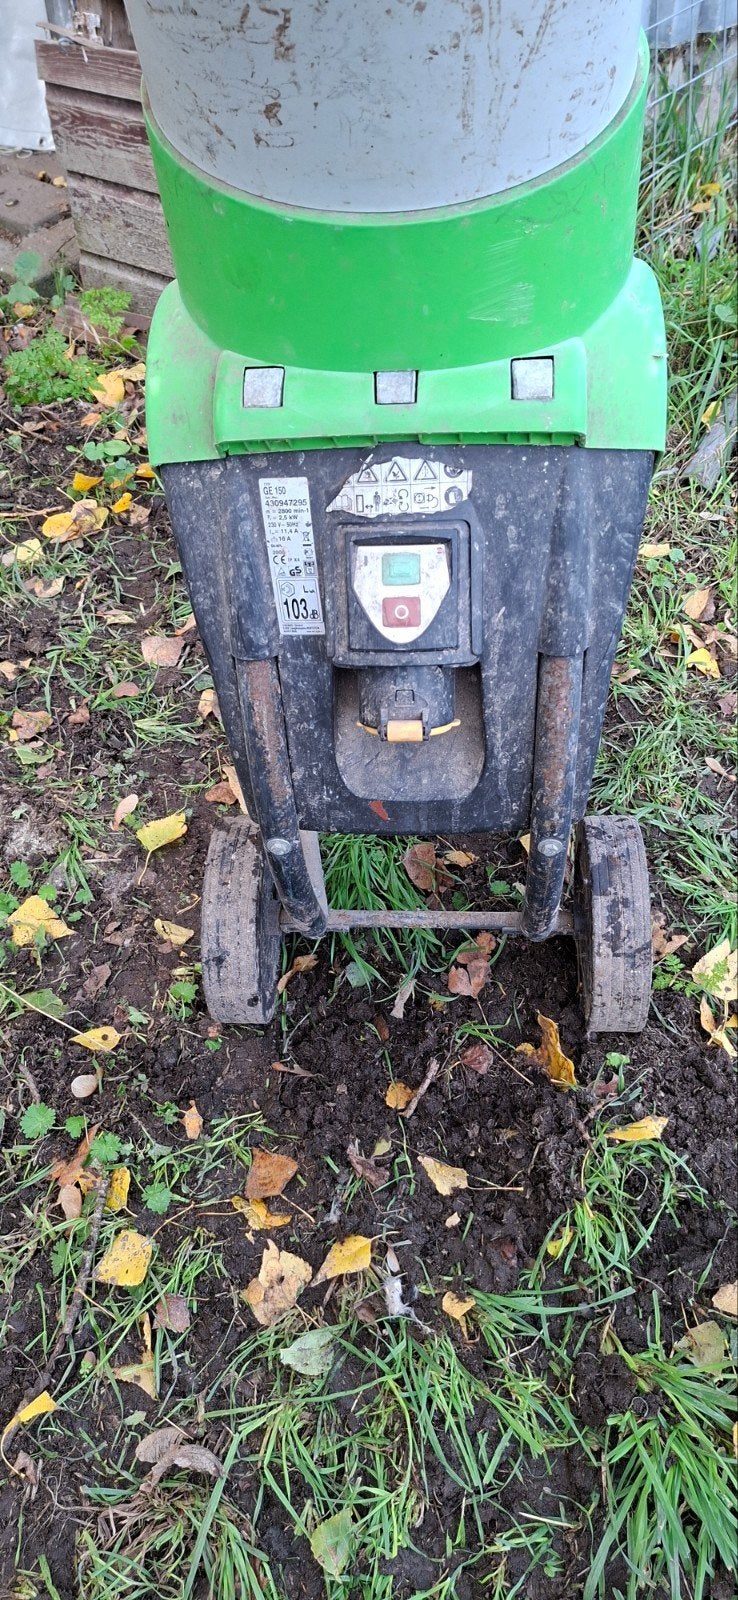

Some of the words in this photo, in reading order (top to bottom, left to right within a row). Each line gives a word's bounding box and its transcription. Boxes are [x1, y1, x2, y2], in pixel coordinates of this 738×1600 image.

[263, 486, 273, 495] GE
[274, 486, 286, 494] 150
[289, 566, 302, 576] GS
[284, 598, 308, 619] 103
